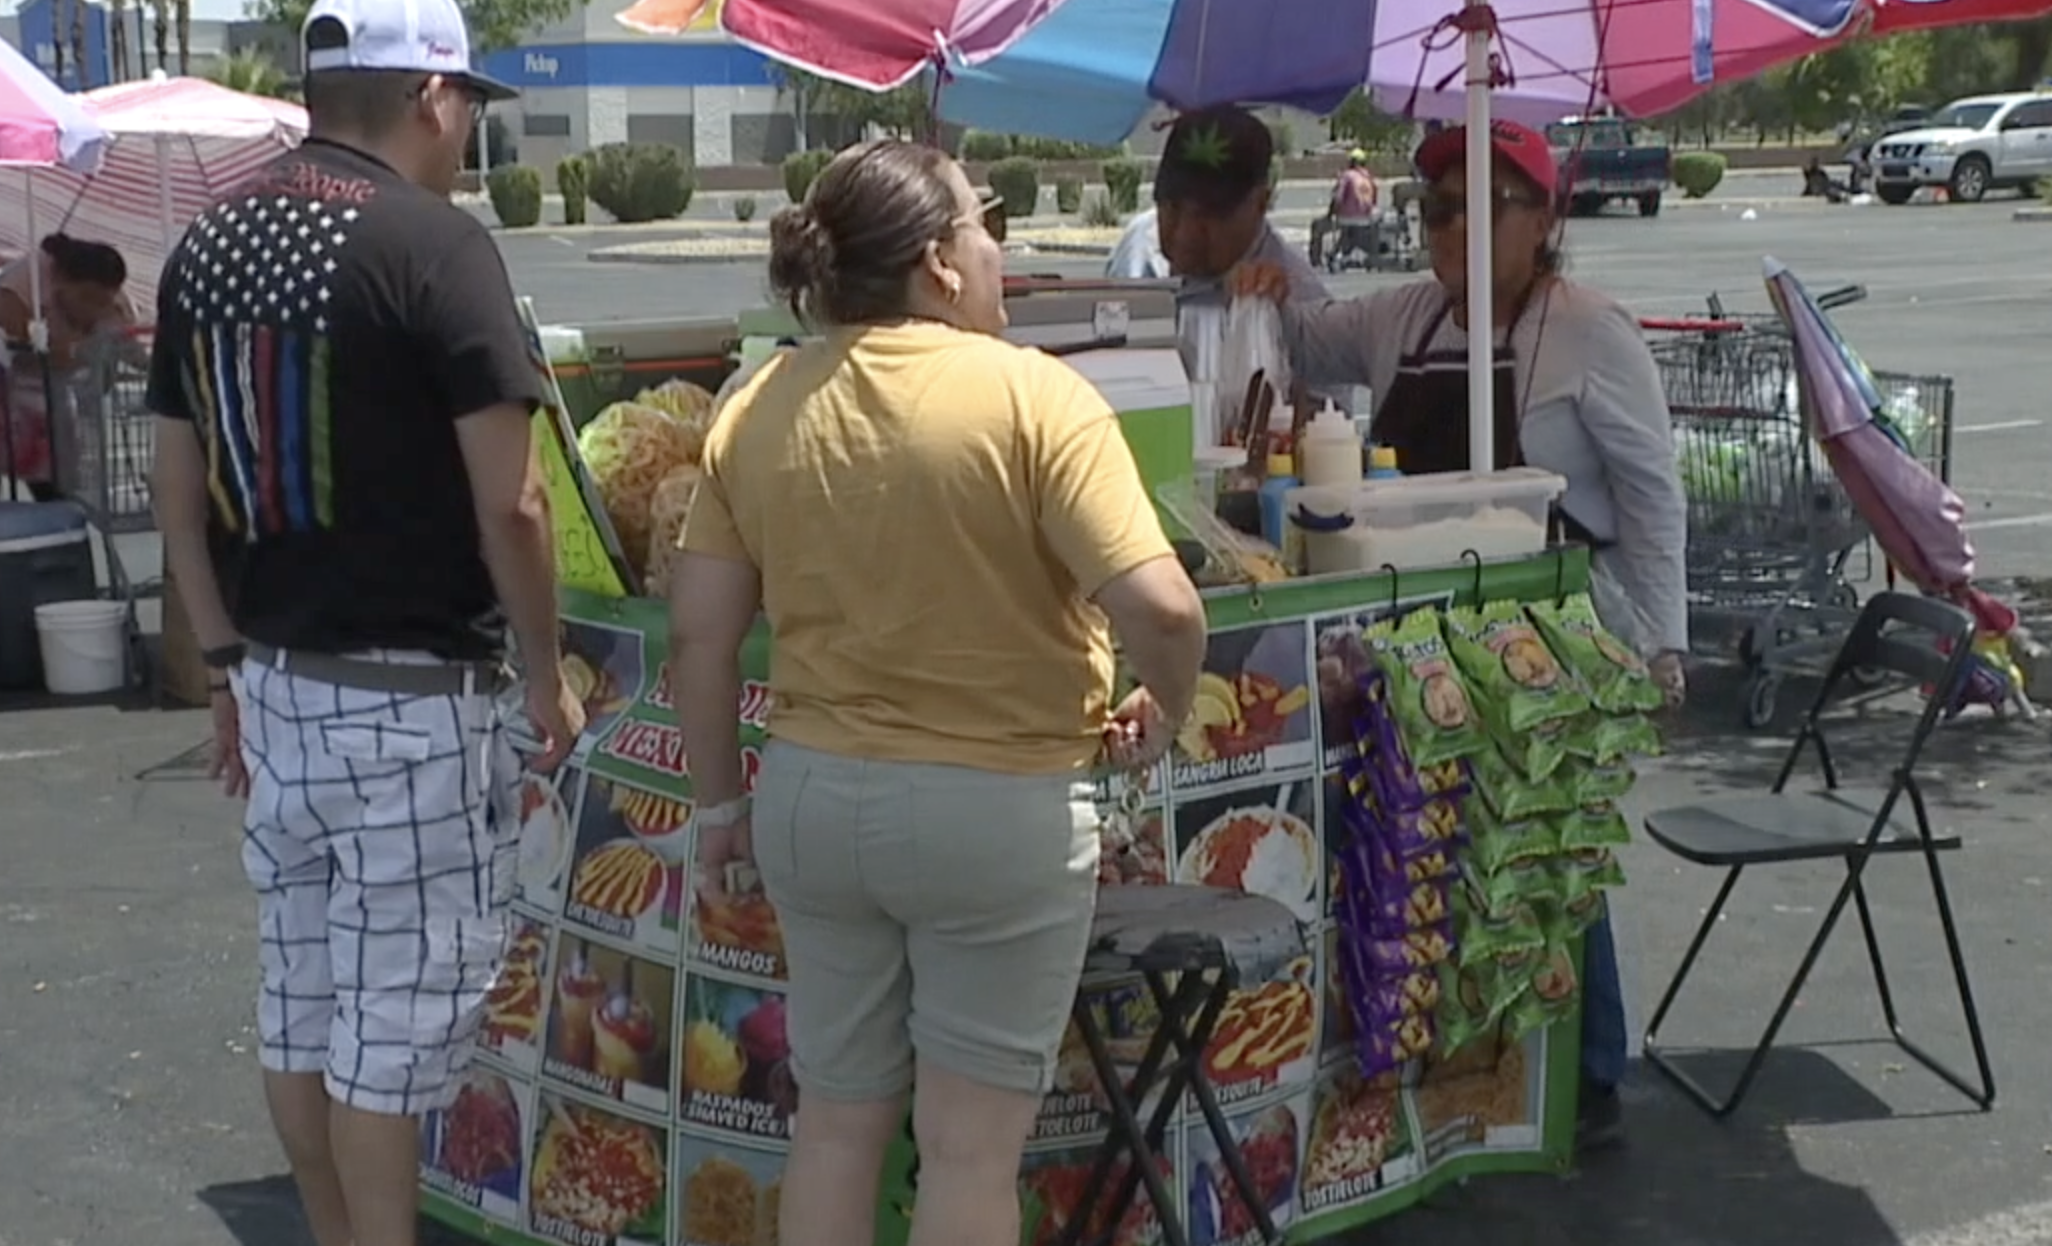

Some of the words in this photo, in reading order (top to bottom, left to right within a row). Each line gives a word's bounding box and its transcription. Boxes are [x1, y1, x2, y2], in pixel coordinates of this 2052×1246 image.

[524, 53, 559, 79] Pickup
[1173, 757, 1228, 787] SANGRIA
[1229, 750, 1264, 775] LOCA
[702, 940, 777, 975] MANGOS
[692, 1089, 776, 1118] RASPADOS
